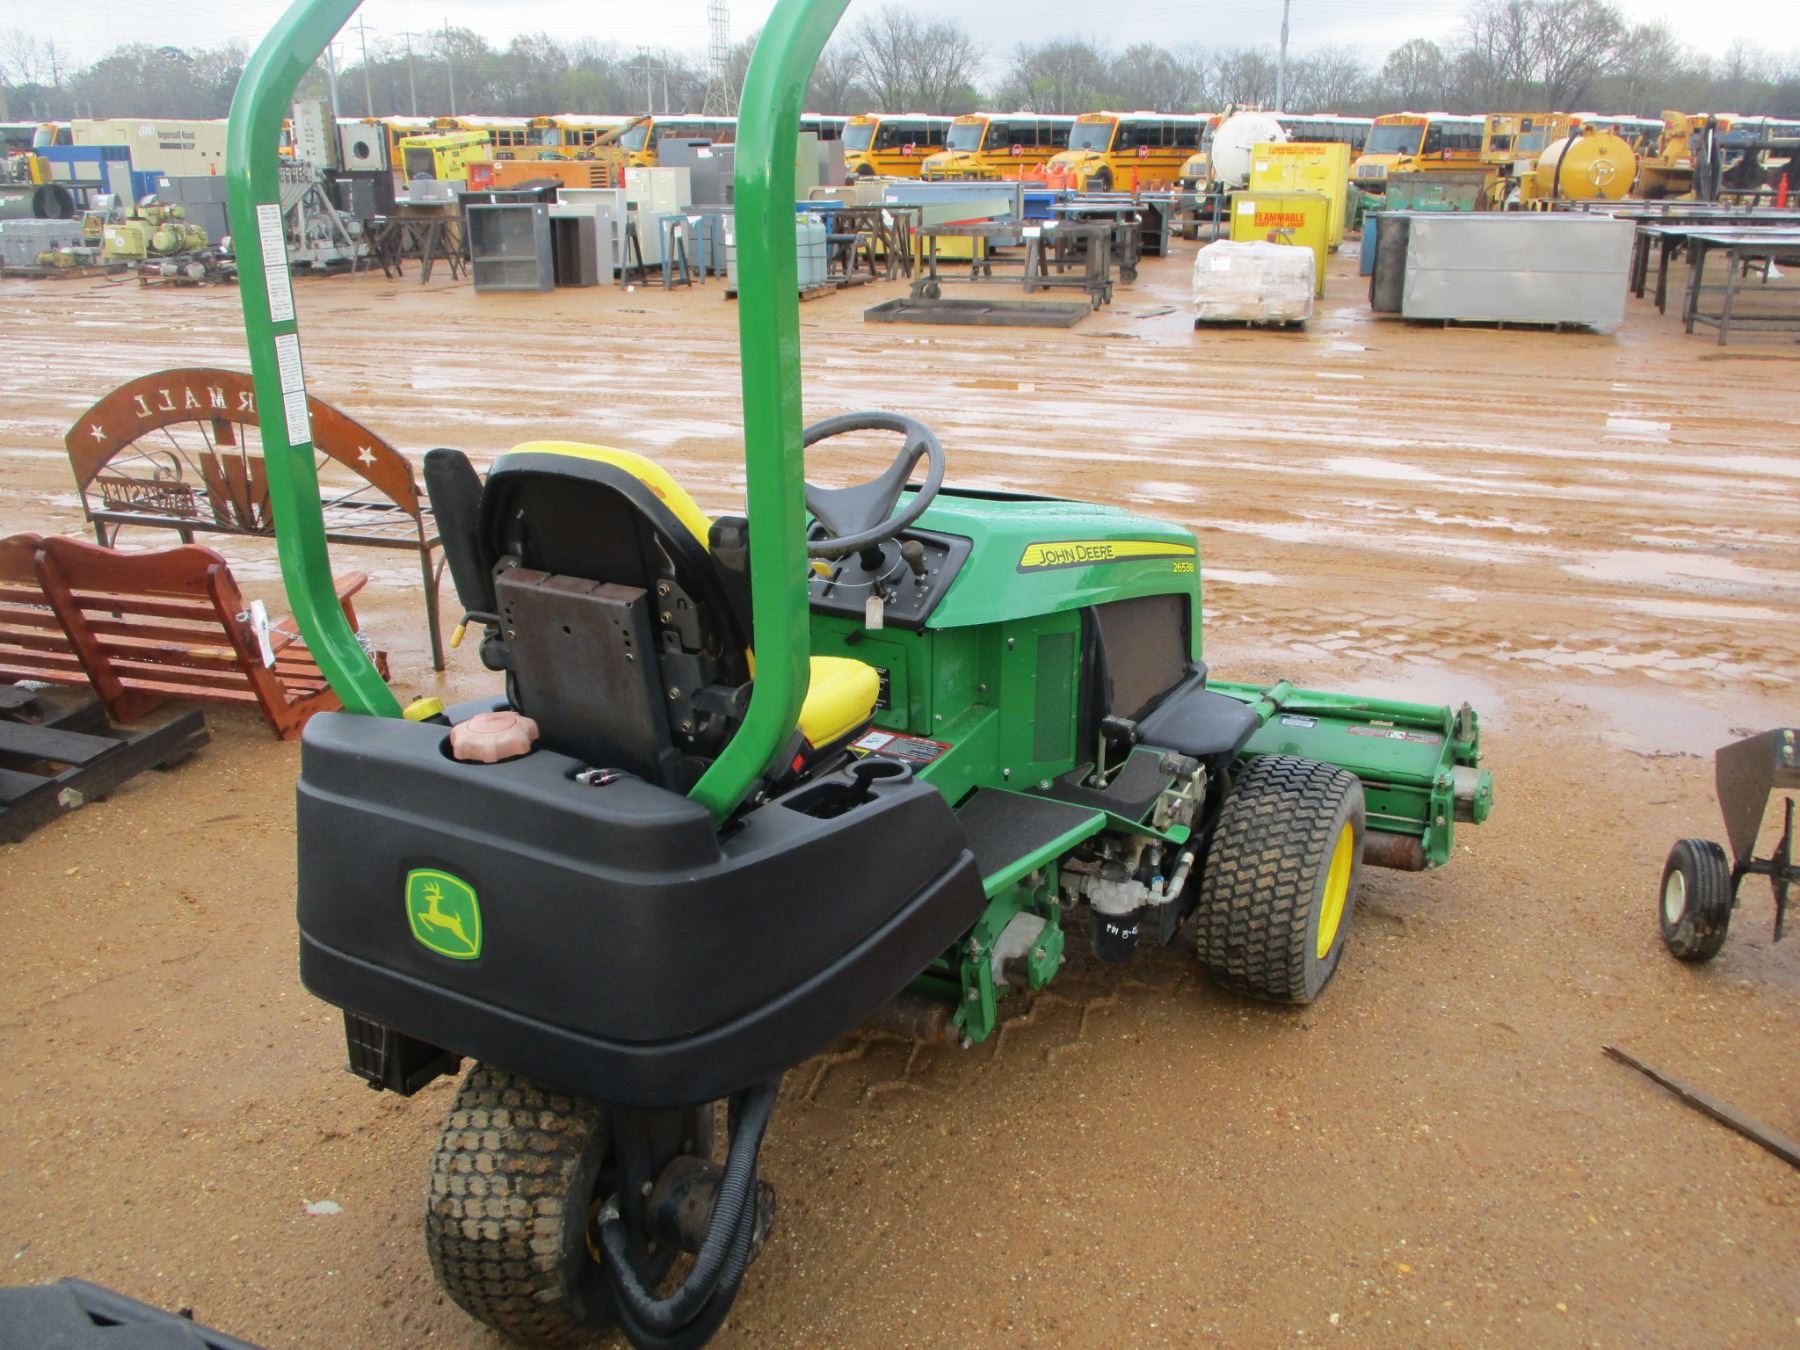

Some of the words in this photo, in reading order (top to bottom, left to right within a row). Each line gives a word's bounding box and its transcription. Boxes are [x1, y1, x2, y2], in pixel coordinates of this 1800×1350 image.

[1255, 212, 1305, 222] FLAMMABLE
[1039, 549, 1076, 566] JOHN
[1075, 545, 1114, 561] DEERE
